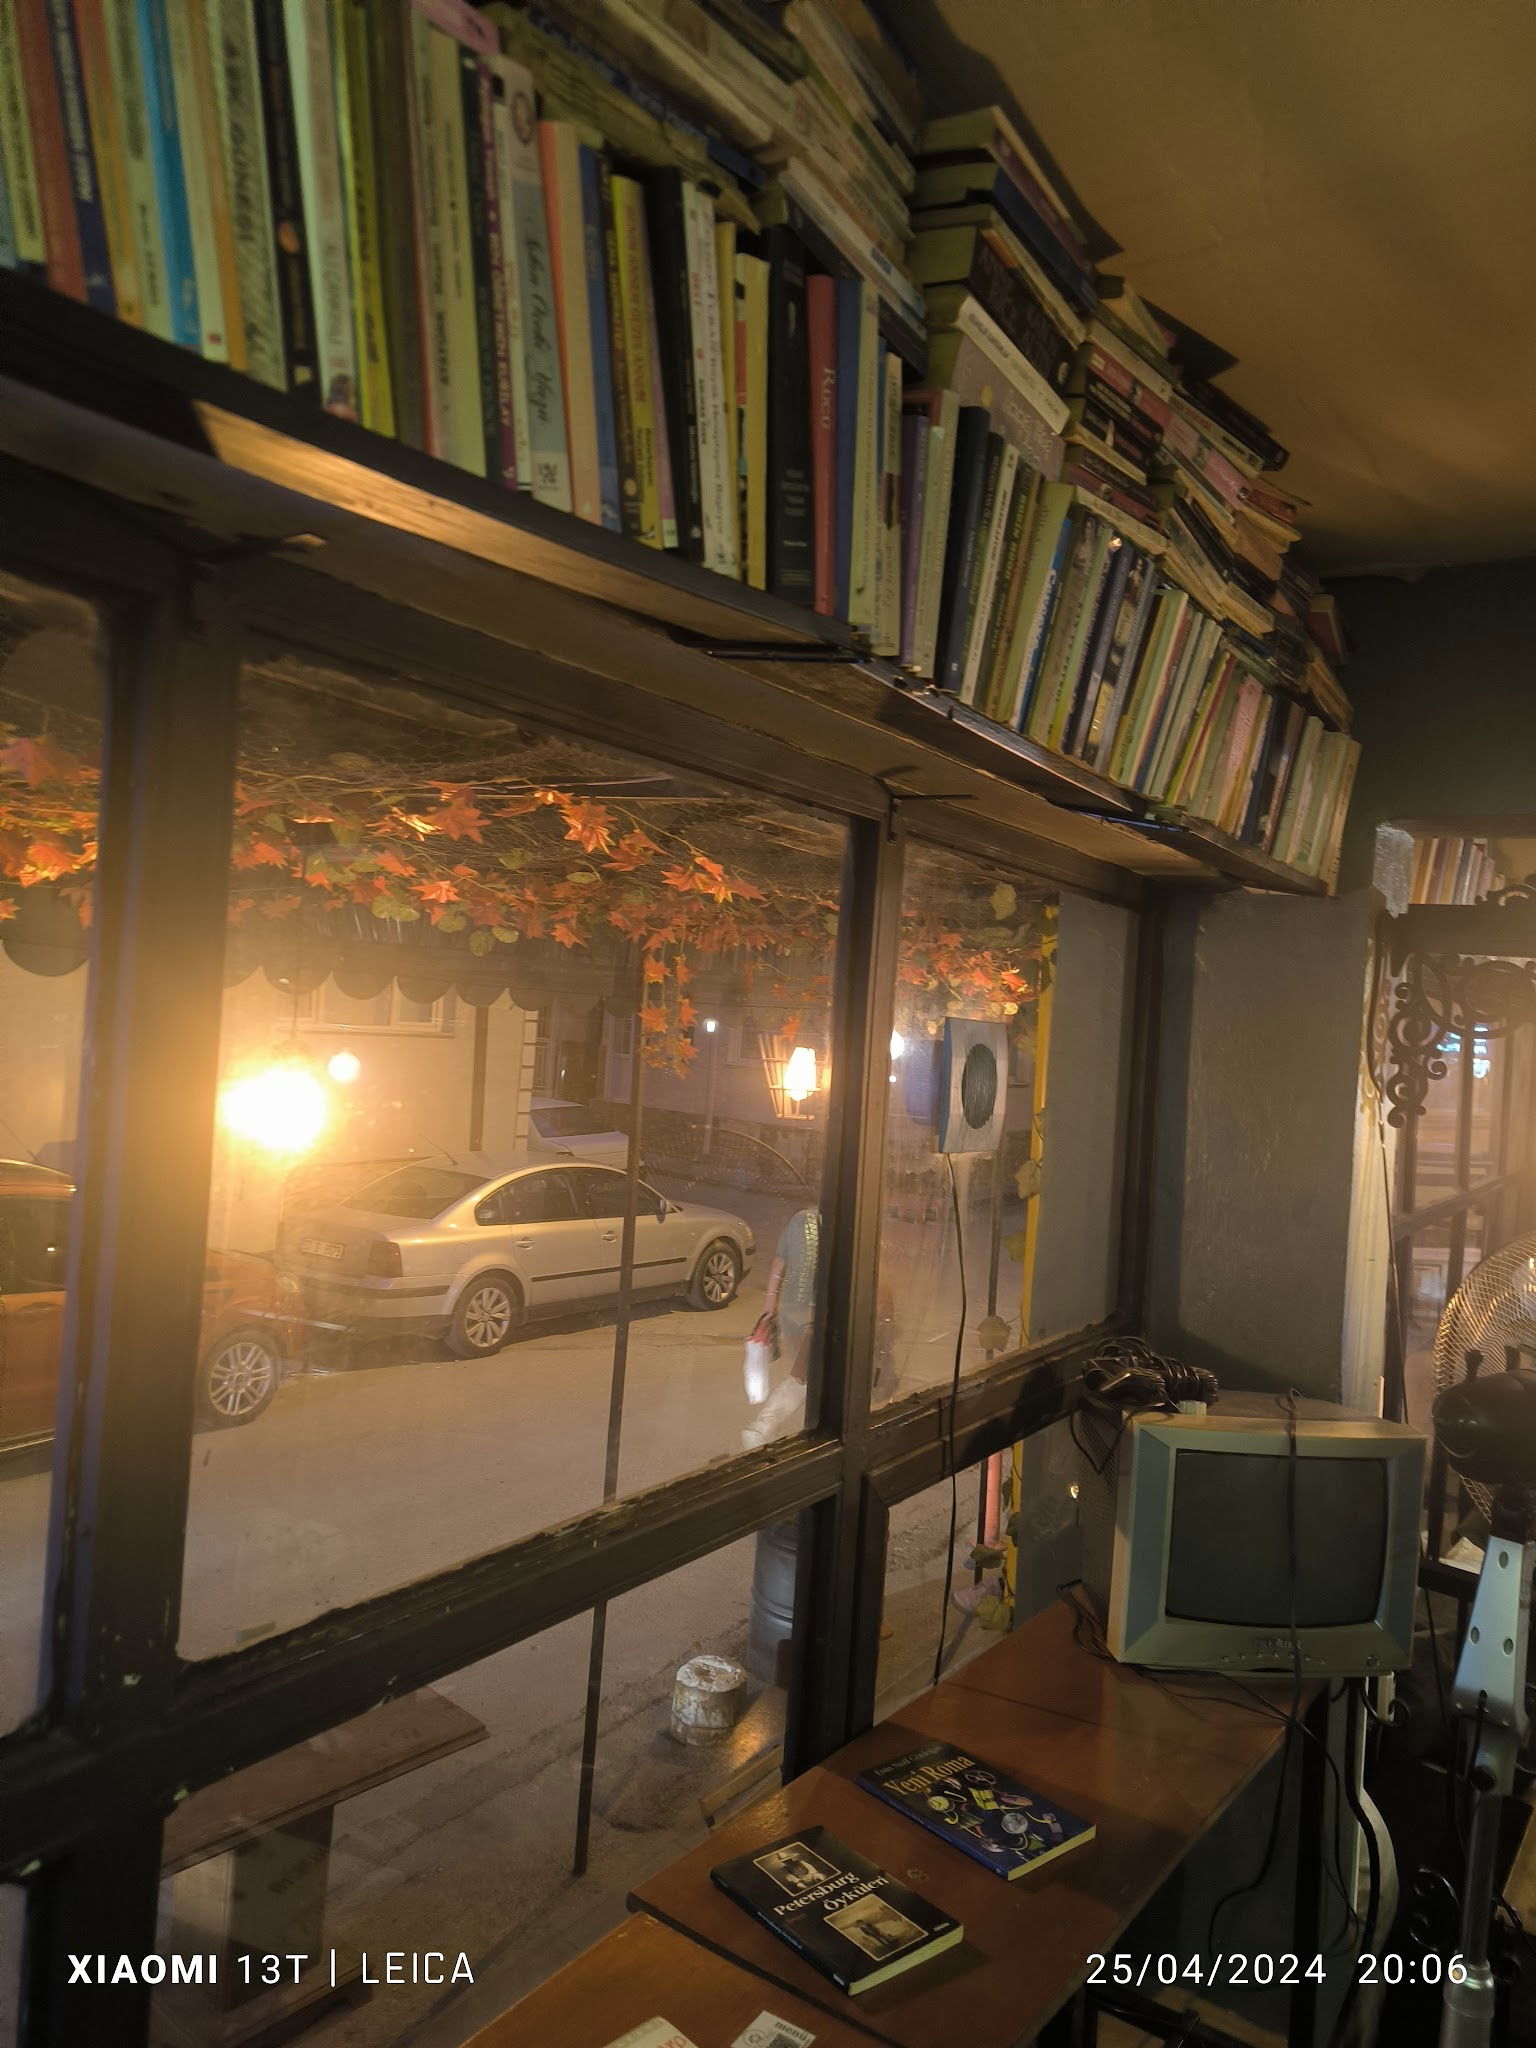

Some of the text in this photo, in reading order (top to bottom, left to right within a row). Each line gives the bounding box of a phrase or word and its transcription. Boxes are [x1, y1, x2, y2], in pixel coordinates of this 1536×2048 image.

[882, 1771, 932, 1796] Yeni
[918, 1756, 977, 1781] Roma
[773, 1872, 860, 1916] Petersburg
[823, 1876, 889, 1911] Öyküleri
